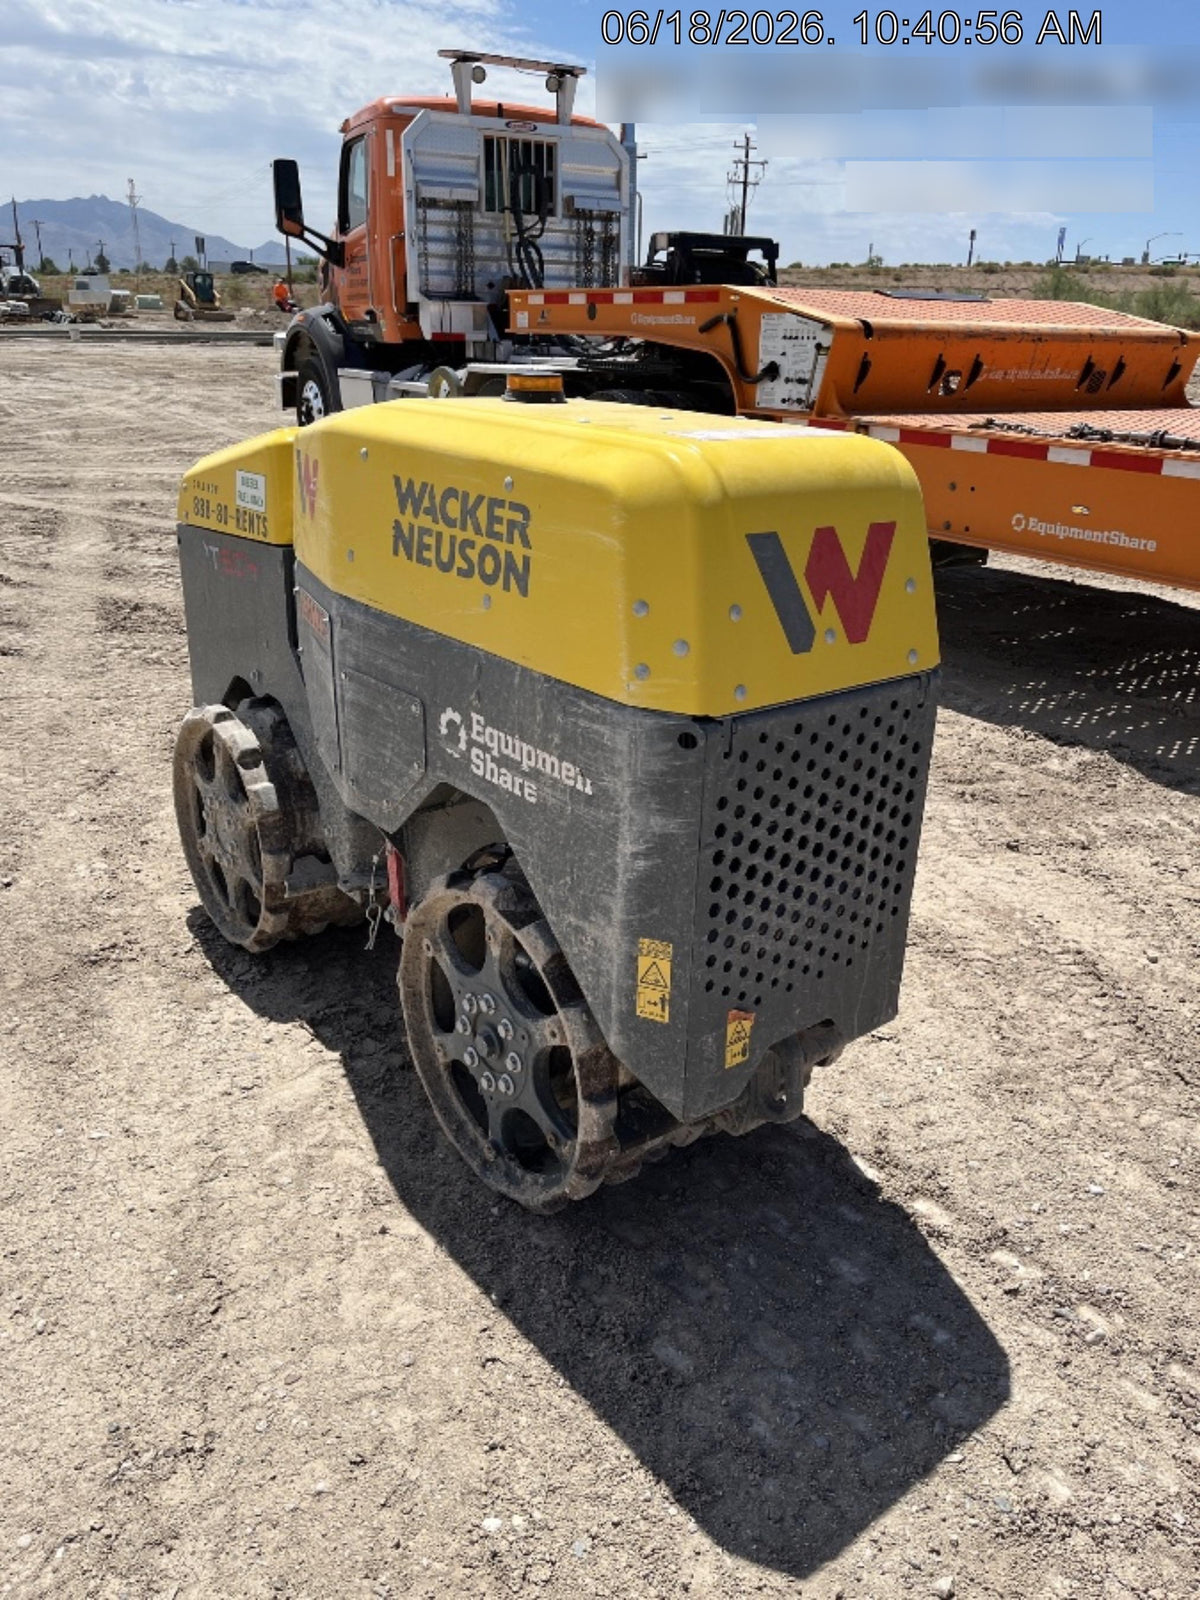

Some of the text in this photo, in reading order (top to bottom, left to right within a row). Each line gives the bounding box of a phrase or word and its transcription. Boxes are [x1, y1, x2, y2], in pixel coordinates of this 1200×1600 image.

[393, 474, 532, 549] WACKER
[1027, 517, 1157, 552] EquipmentShare
[392, 519, 531, 598] NEUSON
[470, 747, 538, 804] Share
